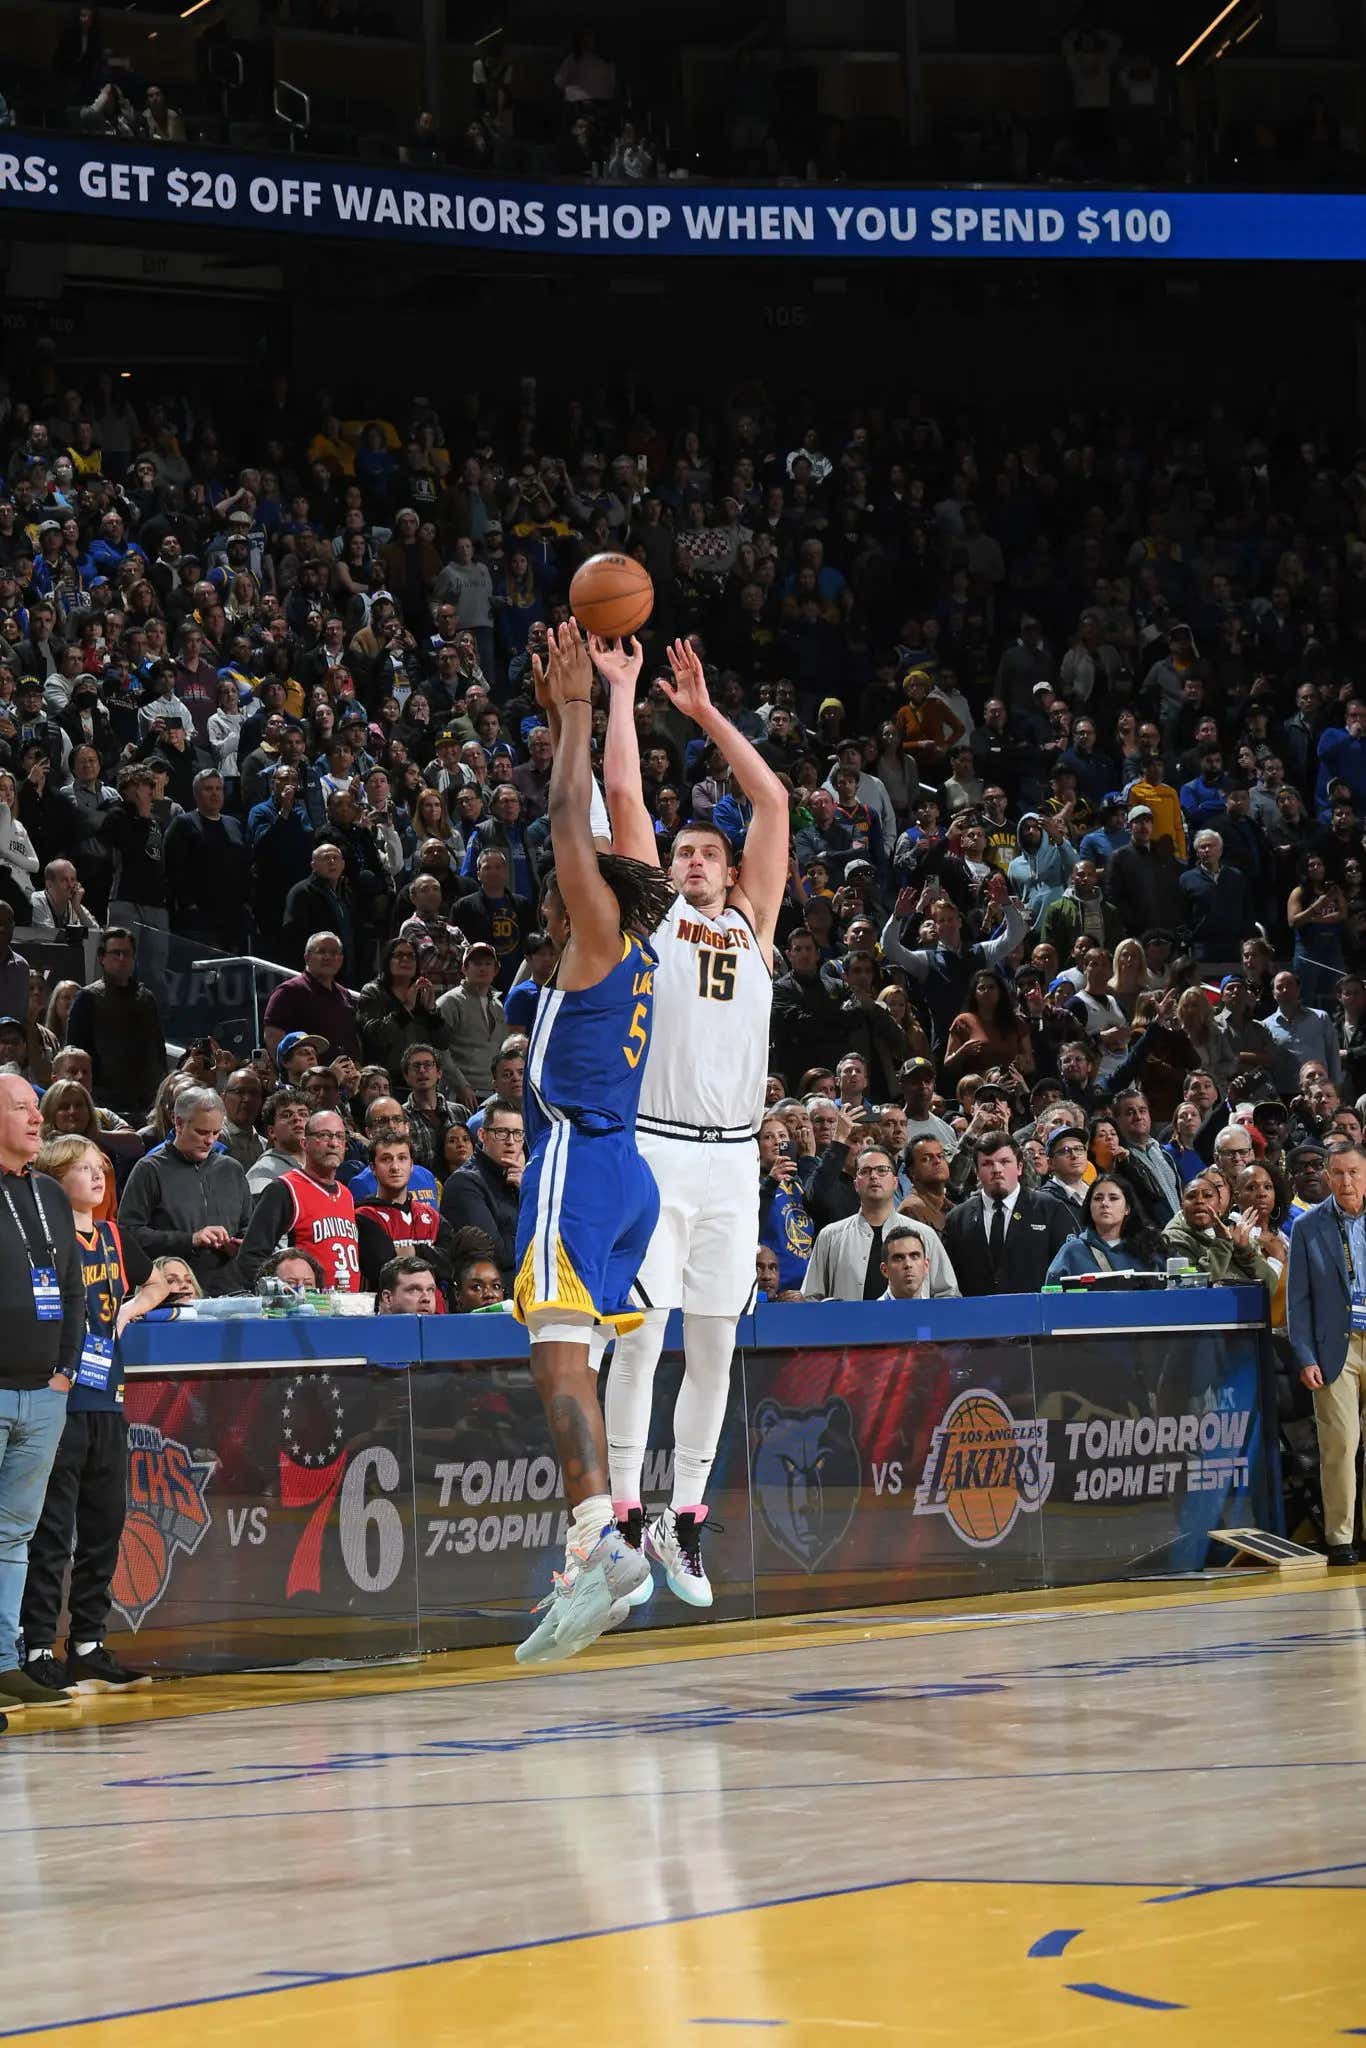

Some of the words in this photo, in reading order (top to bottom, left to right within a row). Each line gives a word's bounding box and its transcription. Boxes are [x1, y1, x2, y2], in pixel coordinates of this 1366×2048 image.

[80, 162, 155, 202] GET
[167, 167, 237, 210] $20
[249, 177, 321, 217] OFF
[333, 184, 545, 236] WARRIORS
[556, 204, 671, 239] SHOP
[682, 206, 814, 240] WHEN
[827, 207, 917, 241] YOU
[931, 208, 1065, 242] SPEND
[1077, 207, 1171, 244] $100
[492, 920, 512, 936] 30
[676, 918, 750, 951] NUGGETS
[697, 948, 738, 1001] 15
[622, 1001, 648, 1069] 5
[312, 1217, 359, 1244] DAVIDSO
[82, 1261, 119, 1288] KLAD
[331, 1242, 360, 1273] 30
[959, 1431, 983, 1444] LOS
[984, 1425, 1044, 1444] ANGELES
[1064, 1410, 1251, 1461] TOMORROW
[871, 1461, 904, 1496] VS
[927, 1429, 1044, 1503] LAKERS
[1072, 1464, 1145, 1502] 10PM
[1147, 1461, 1183, 1495] ET
[1187, 1456, 1250, 1492] ESPN
[227, 1506, 268, 1546] VS
[277, 1443, 406, 1601] 76
[425, 1511, 550, 1557] 7:30PM
